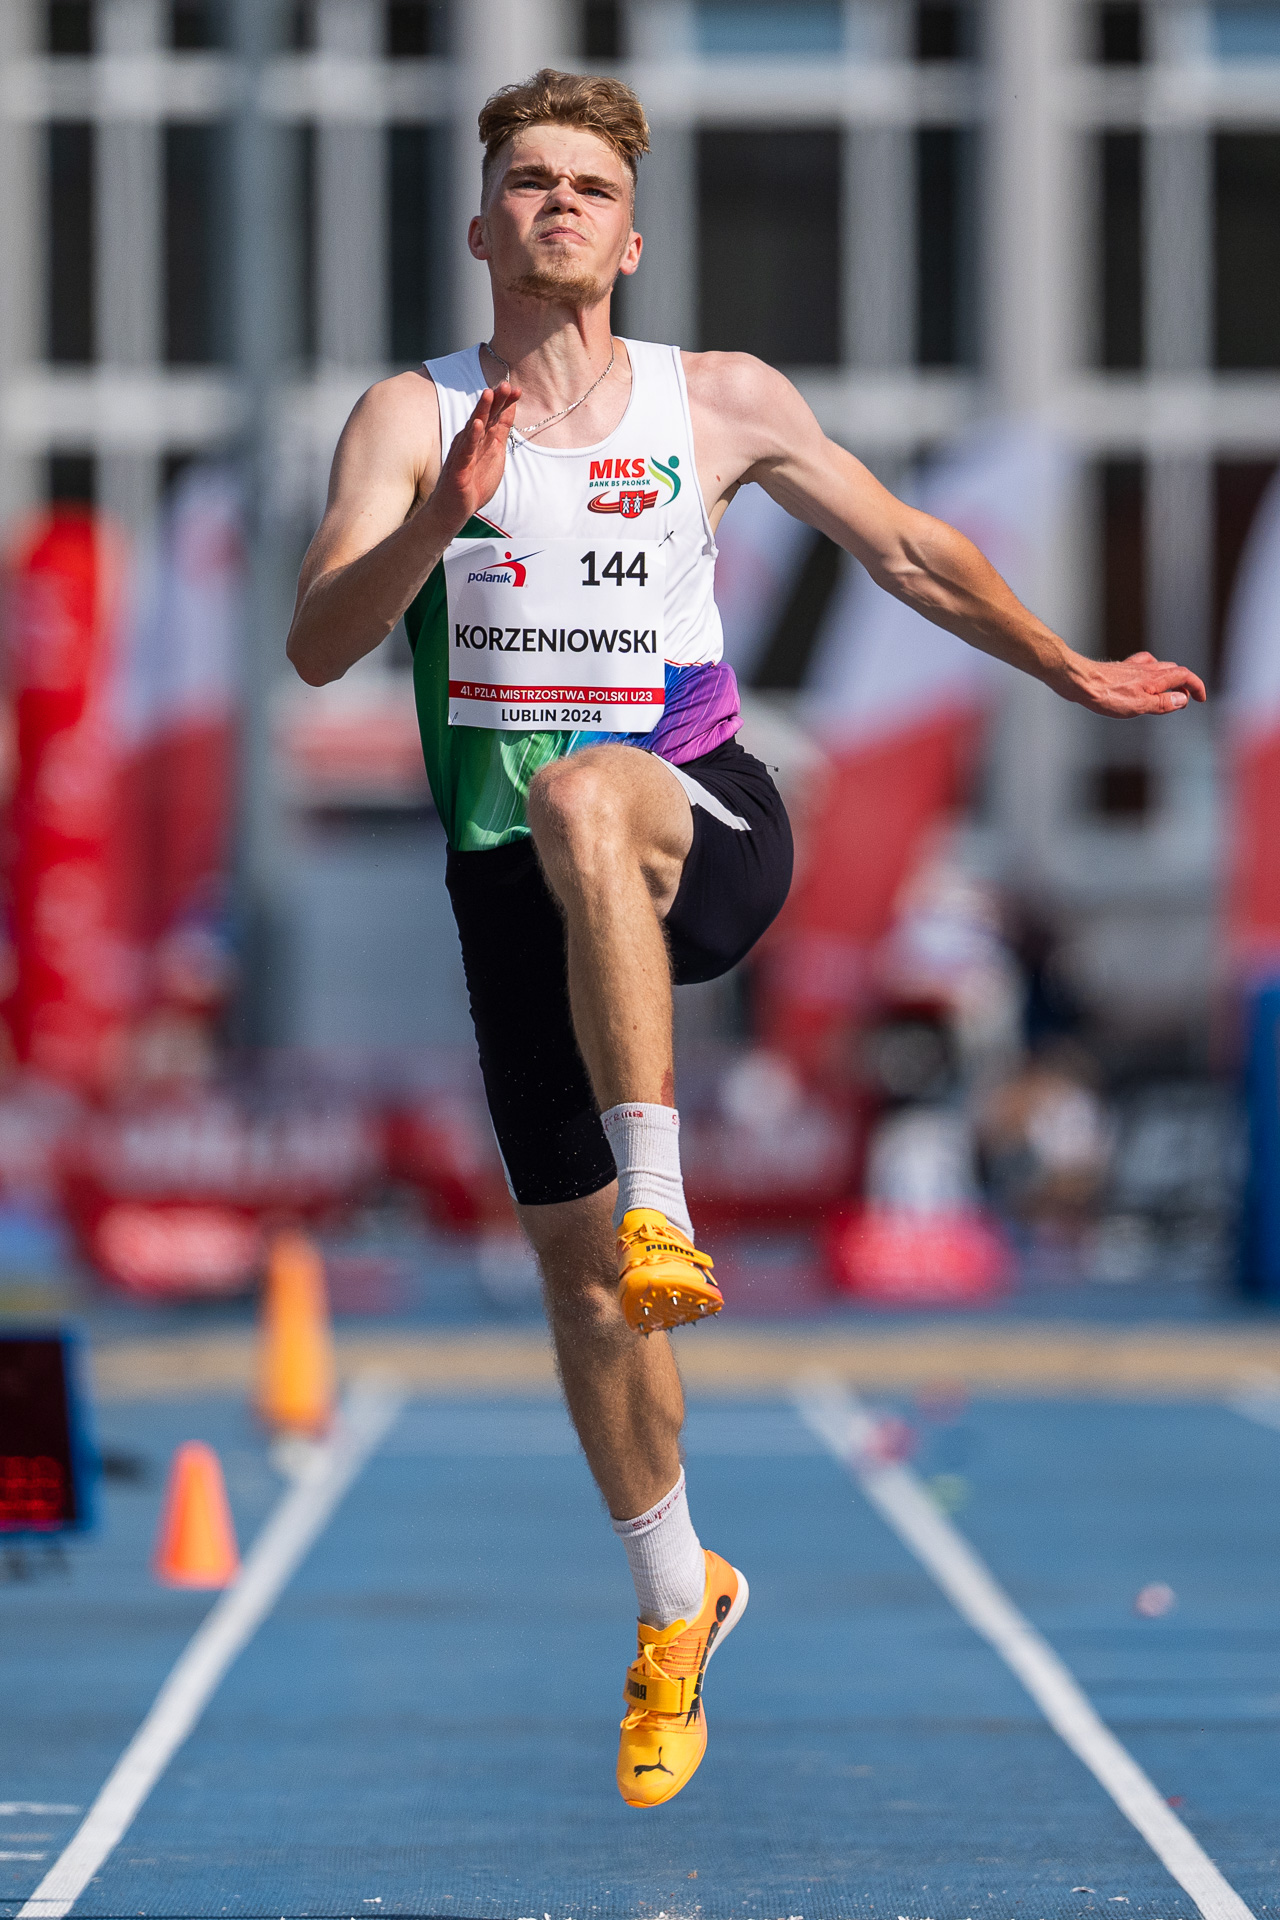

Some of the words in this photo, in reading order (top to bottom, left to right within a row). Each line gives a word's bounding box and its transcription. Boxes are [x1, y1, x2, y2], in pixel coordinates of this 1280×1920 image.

[589, 458, 645, 480] MKS
[589, 480, 609, 488] BANK
[622, 478, 651, 487] PŁOŃSK
[467, 571, 512, 583] polanik
[580, 551, 648, 587] 144
[455, 623, 657, 654] KORZENIOWSKI
[460, 685, 473, 697] 41.
[474, 687, 497, 699] PZLA
[499, 689, 586, 701] MISTRZOSTWA
[588, 691, 628, 702] POLSKI
[630, 692, 653, 702] U23
[501, 708, 557, 722] LUBLIN
[560, 708, 602, 723] 2024
